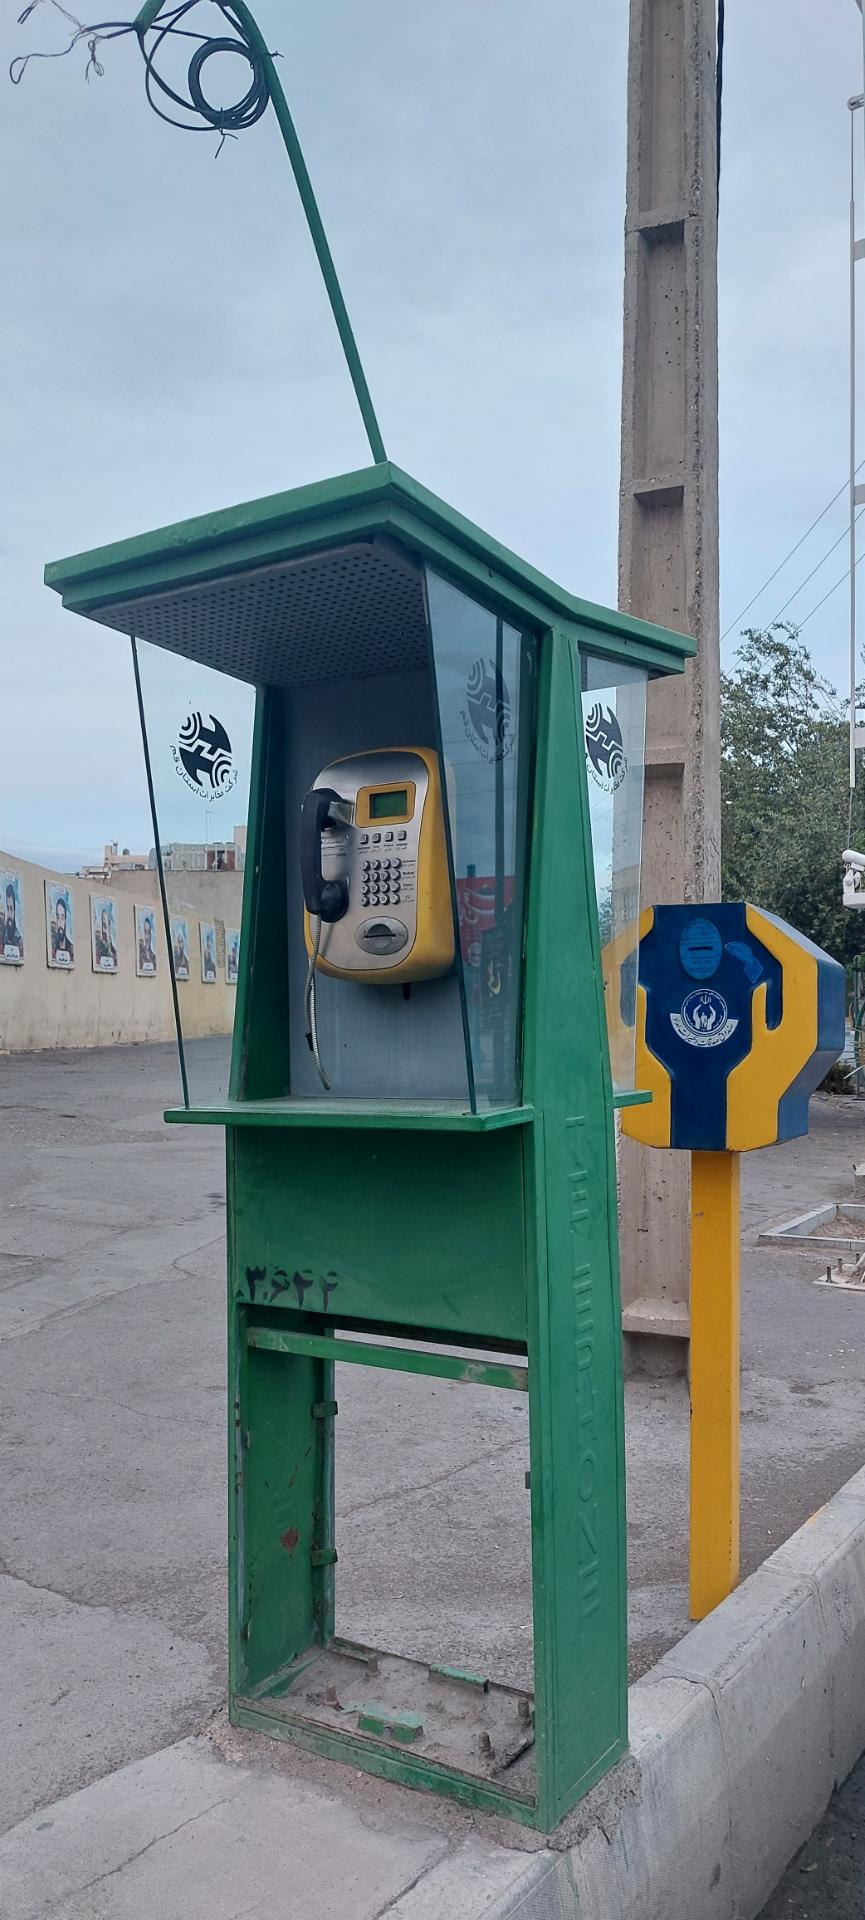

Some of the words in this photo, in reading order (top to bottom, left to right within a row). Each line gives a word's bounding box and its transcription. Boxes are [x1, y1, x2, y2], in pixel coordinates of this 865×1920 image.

[168, 745, 180, 763] قم
[175, 765, 200, 795] استان
[224, 768, 239, 793] شرکت
[199, 790, 225, 802] مخابرات
